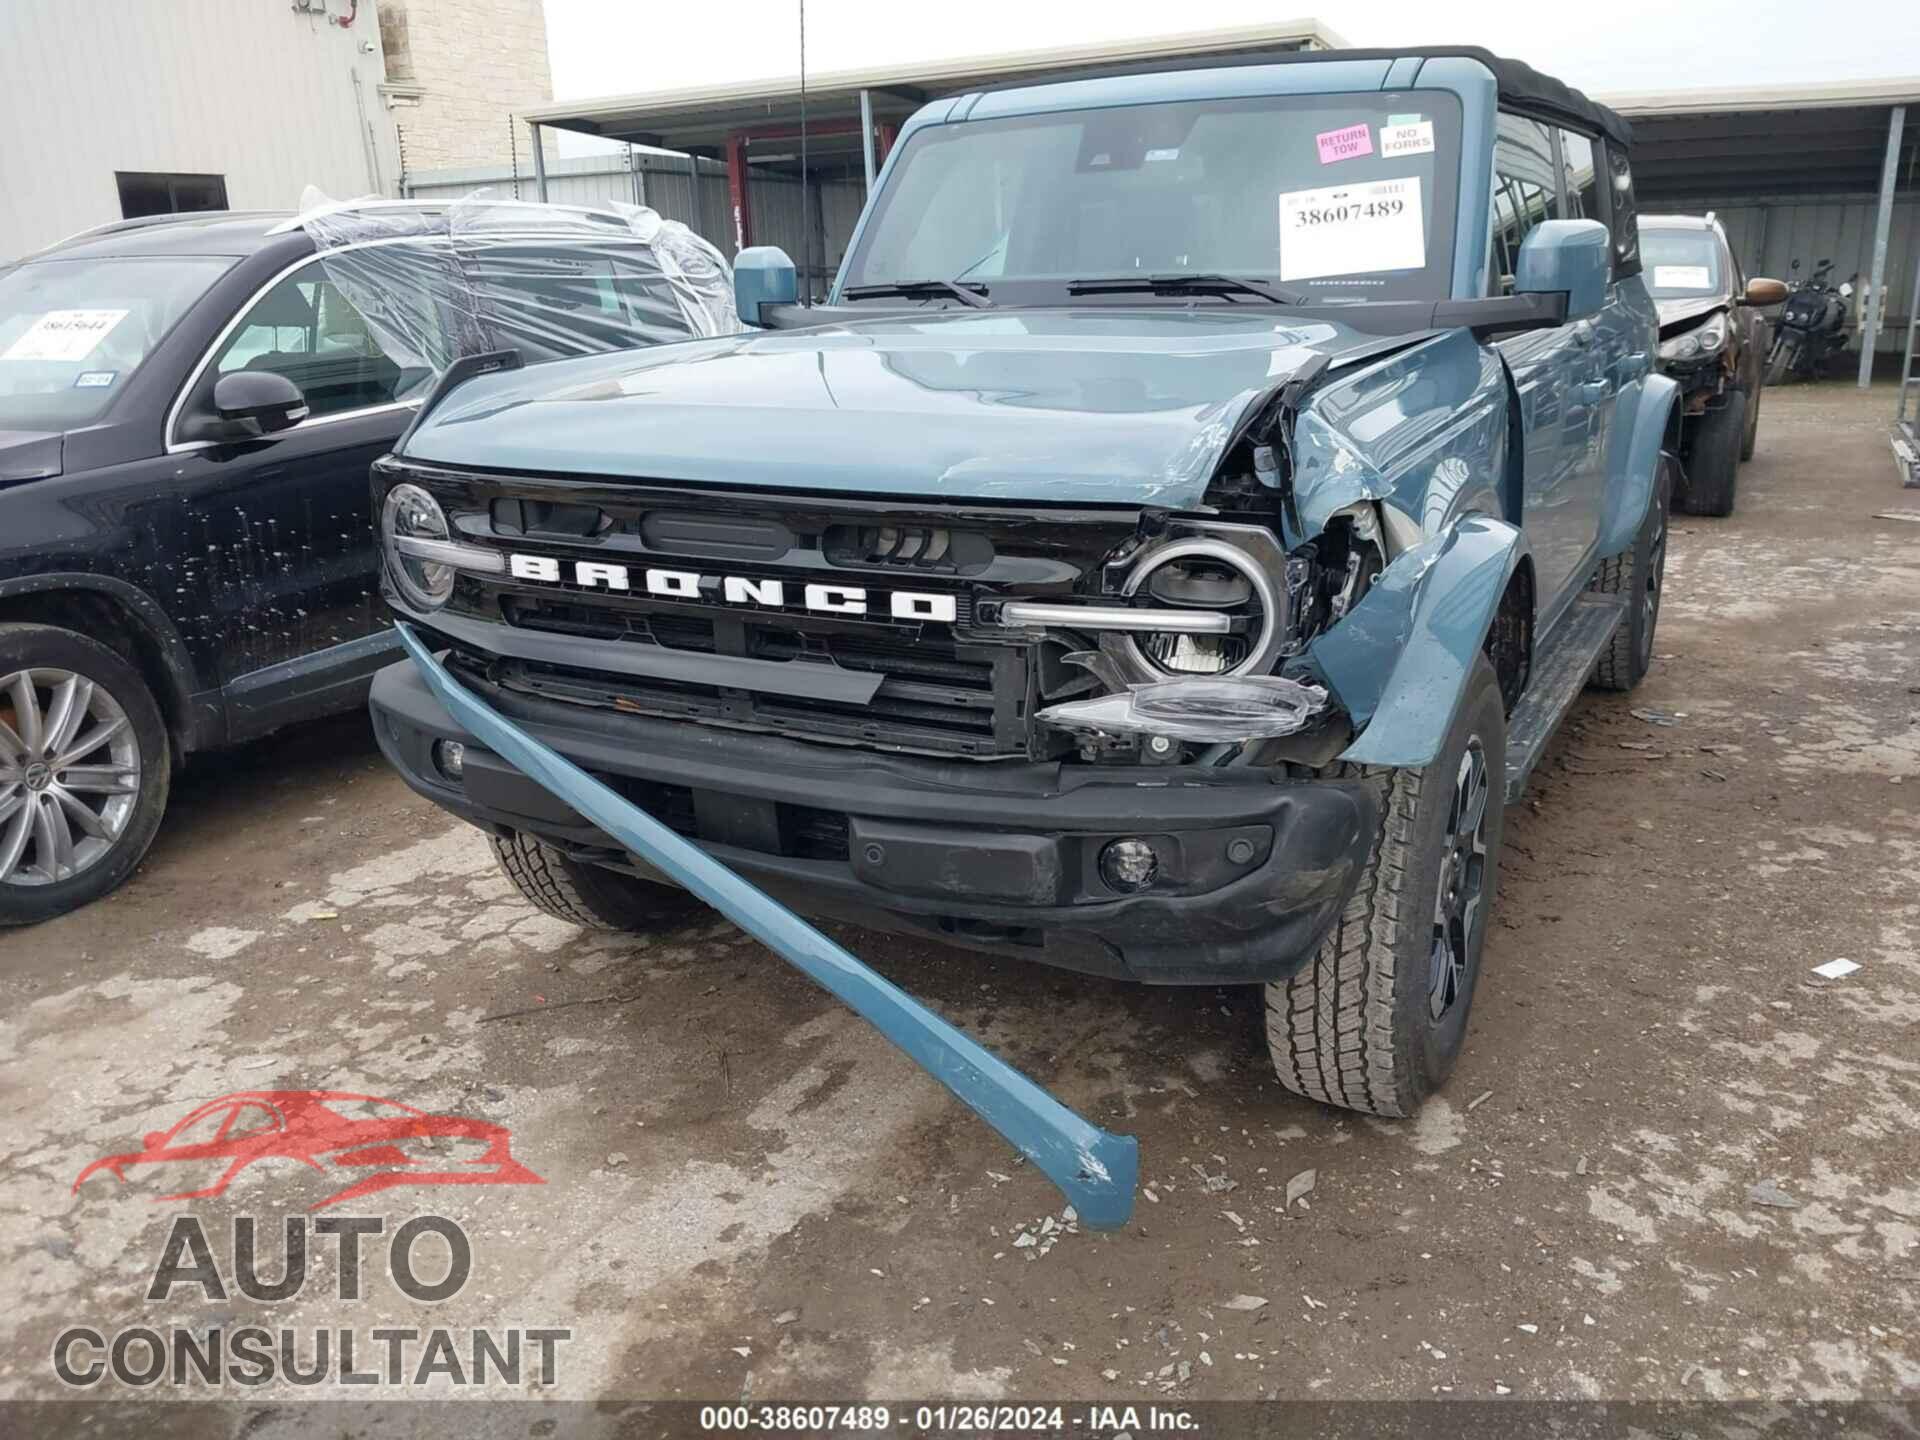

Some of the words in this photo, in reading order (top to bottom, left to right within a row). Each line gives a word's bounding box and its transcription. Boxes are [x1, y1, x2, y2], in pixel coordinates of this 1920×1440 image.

[1320, 128, 1366, 148] RETURN
[1396, 129, 1418, 138] NO
[1333, 142, 1358, 155] TOW
[1384, 137, 1431, 152] FORKS
[1295, 199, 1404, 228] 38607489
[510, 553, 956, 622] BRONCO
